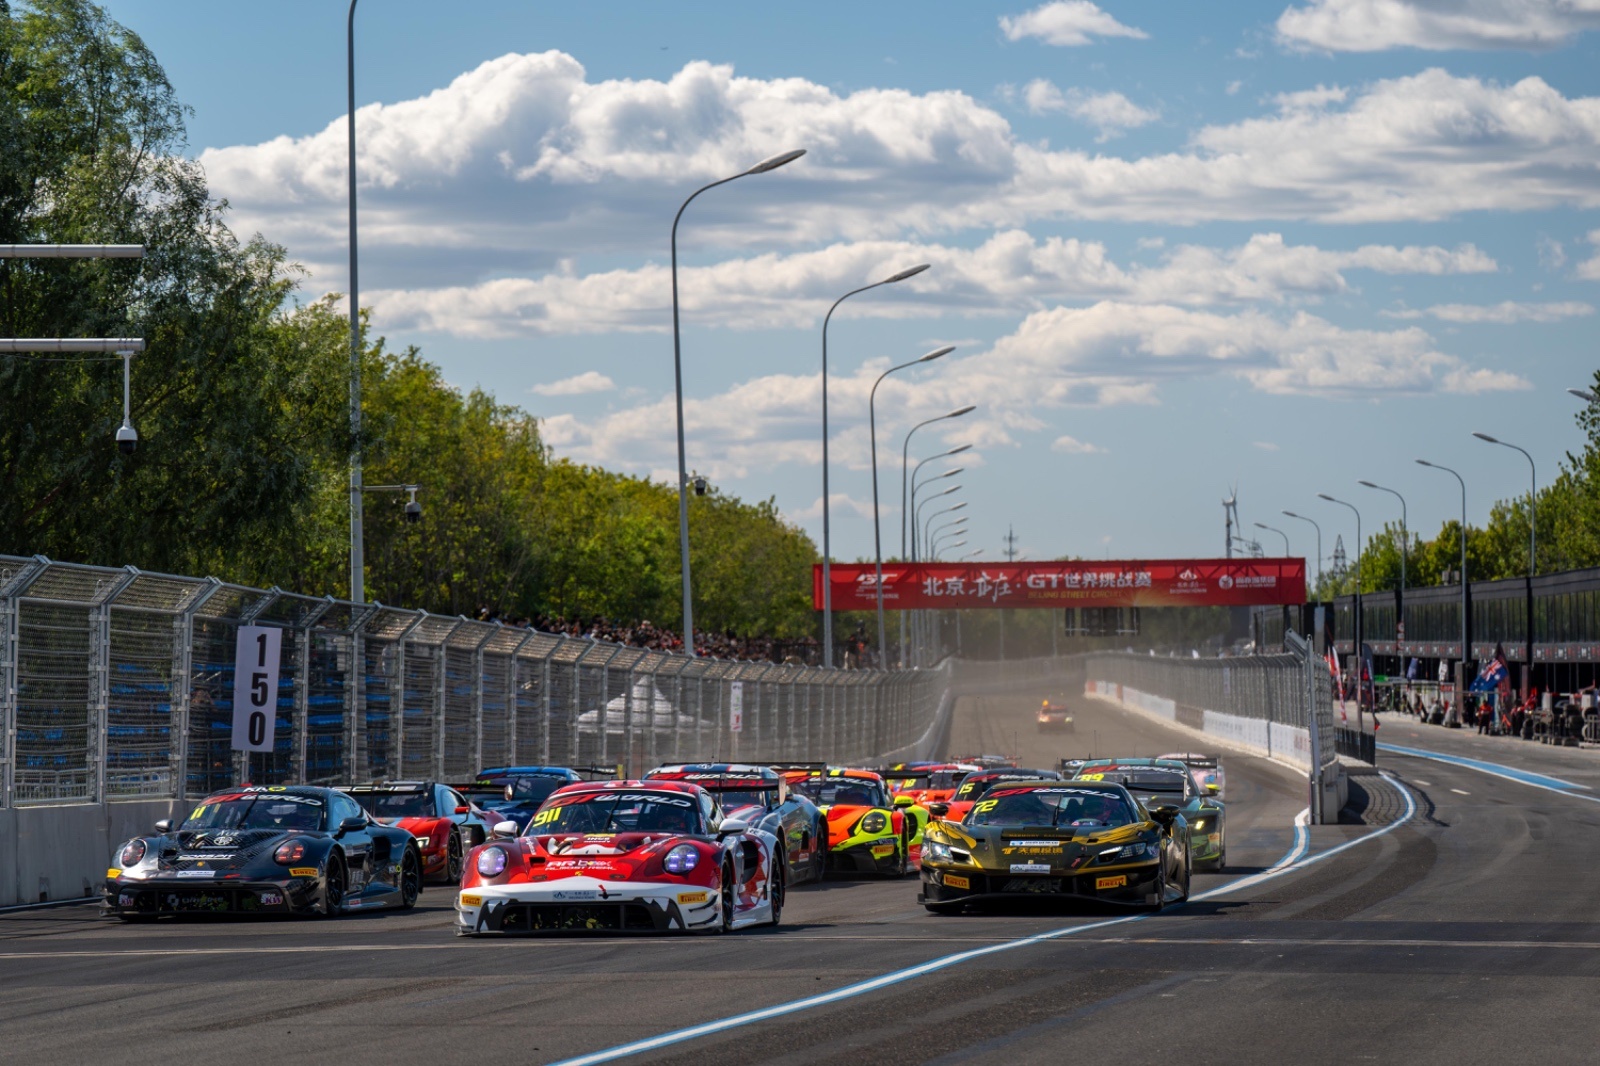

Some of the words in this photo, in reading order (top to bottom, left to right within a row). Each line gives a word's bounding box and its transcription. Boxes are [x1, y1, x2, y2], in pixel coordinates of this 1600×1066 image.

[1028, 591, 1058, 599] BEIJING
[248, 634, 268, 746] 150
[958, 782, 976, 795] 15
[594, 794, 691, 808] WORLD
[973, 799, 999, 814] 72
[189, 805, 207, 821] 11
[532, 807, 562, 828] 911
[292, 869, 318, 877] PIRELLI
[945, 877, 967, 887] PIRELLI
[1098, 877, 1124, 887] PIRELLI
[681, 894, 706, 903] PIRELLI
